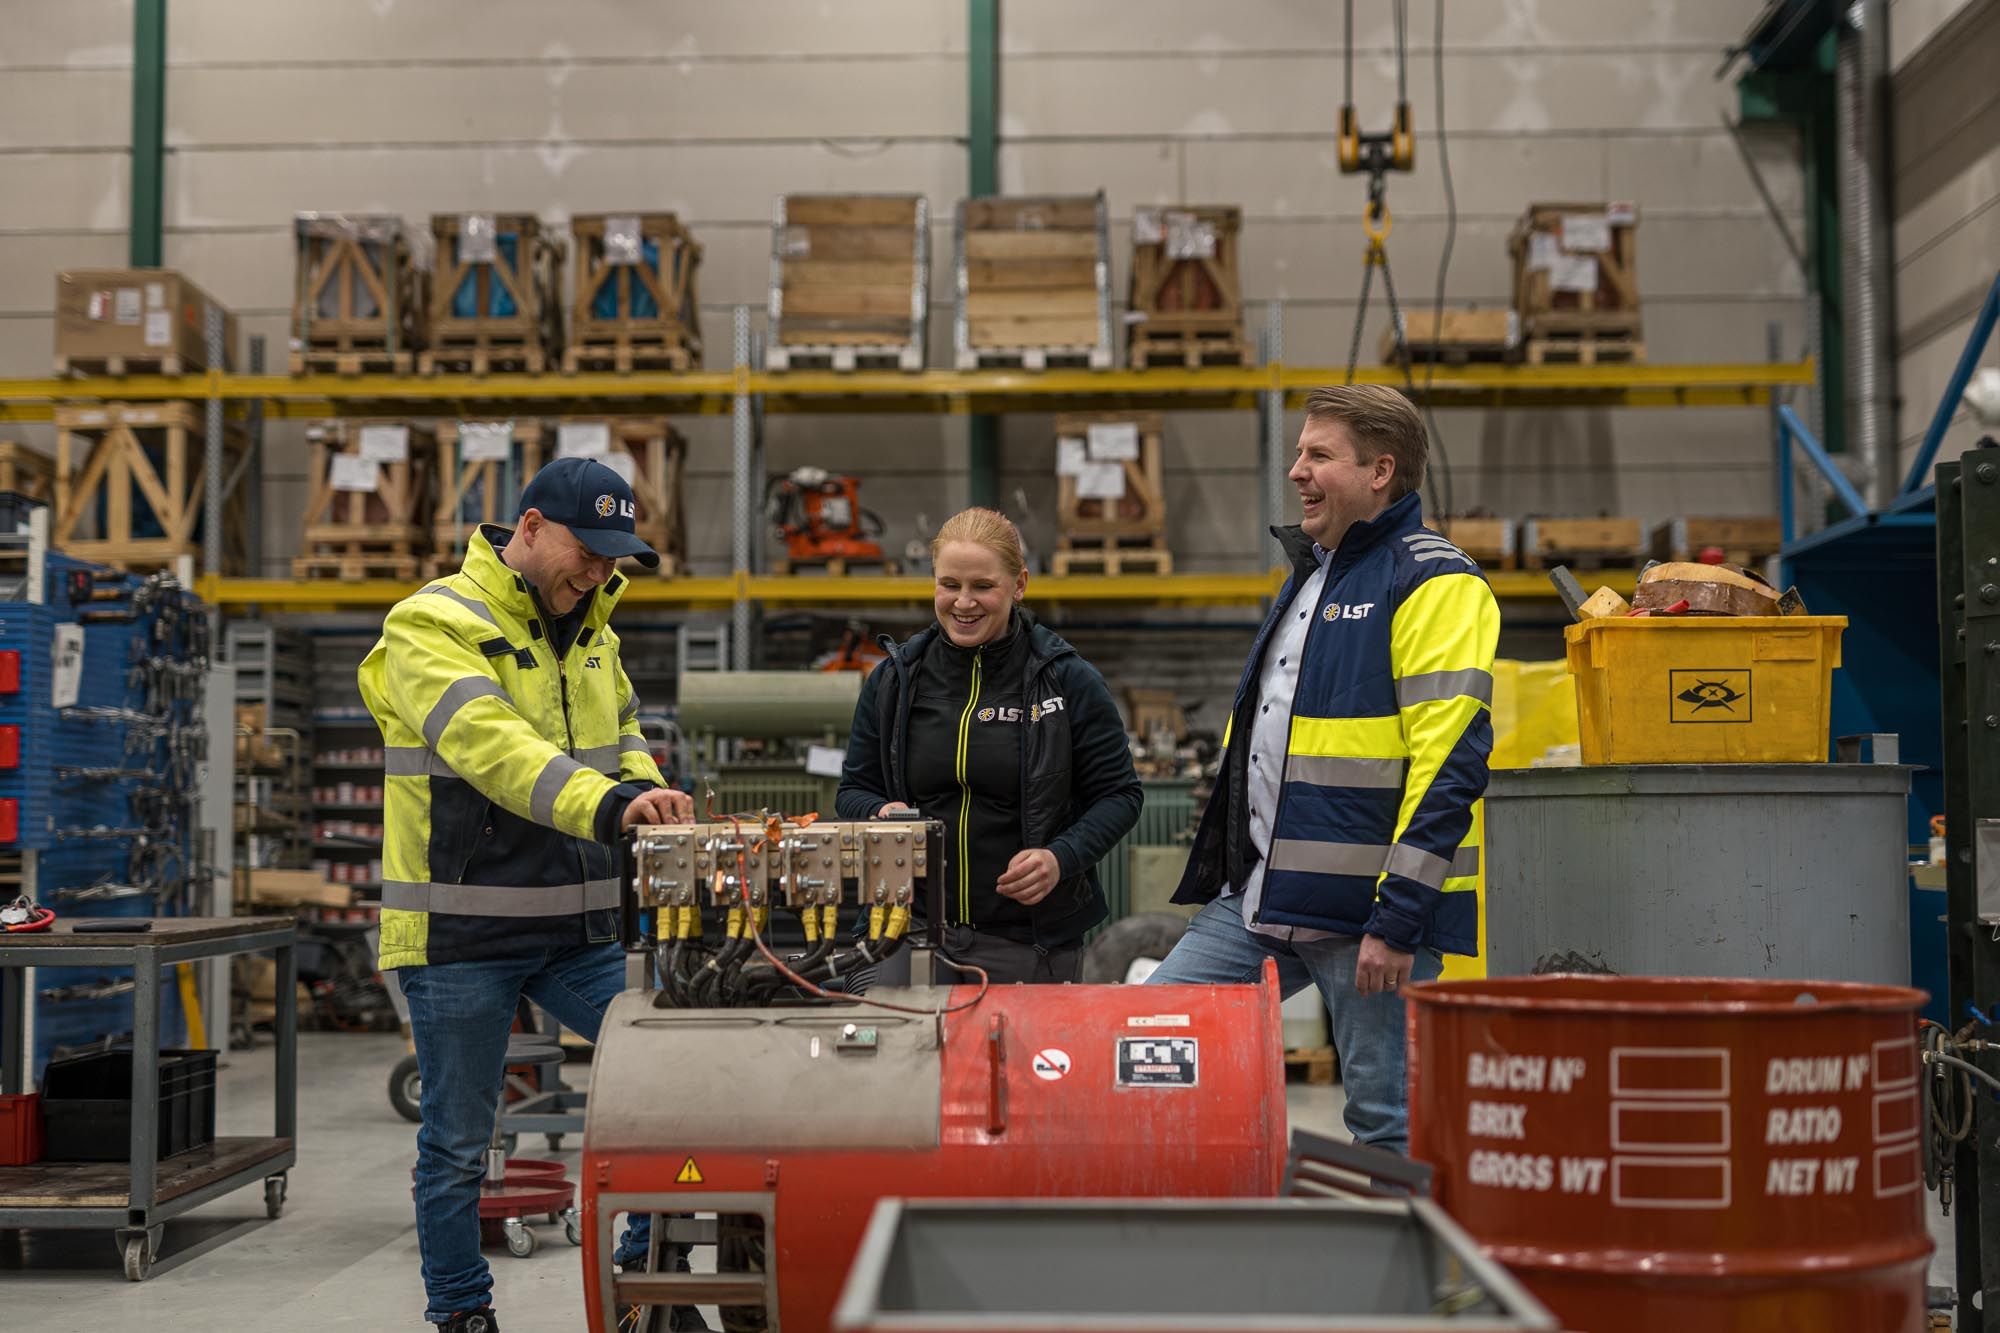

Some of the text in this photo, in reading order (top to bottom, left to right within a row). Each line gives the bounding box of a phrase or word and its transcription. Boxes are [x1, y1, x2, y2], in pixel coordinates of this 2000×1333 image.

[620, 499, 636, 518] LS
[1342, 603, 1375, 619] LST
[585, 656, 601, 669] ST
[1766, 1056, 1843, 1096] DRUM
[1468, 1101, 1528, 1140] BRIX
[1766, 1107, 1841, 1145] RATIO
[1468, 1150, 1607, 1194] GROSS WT
[1766, 1156, 1859, 1196] NET WT
